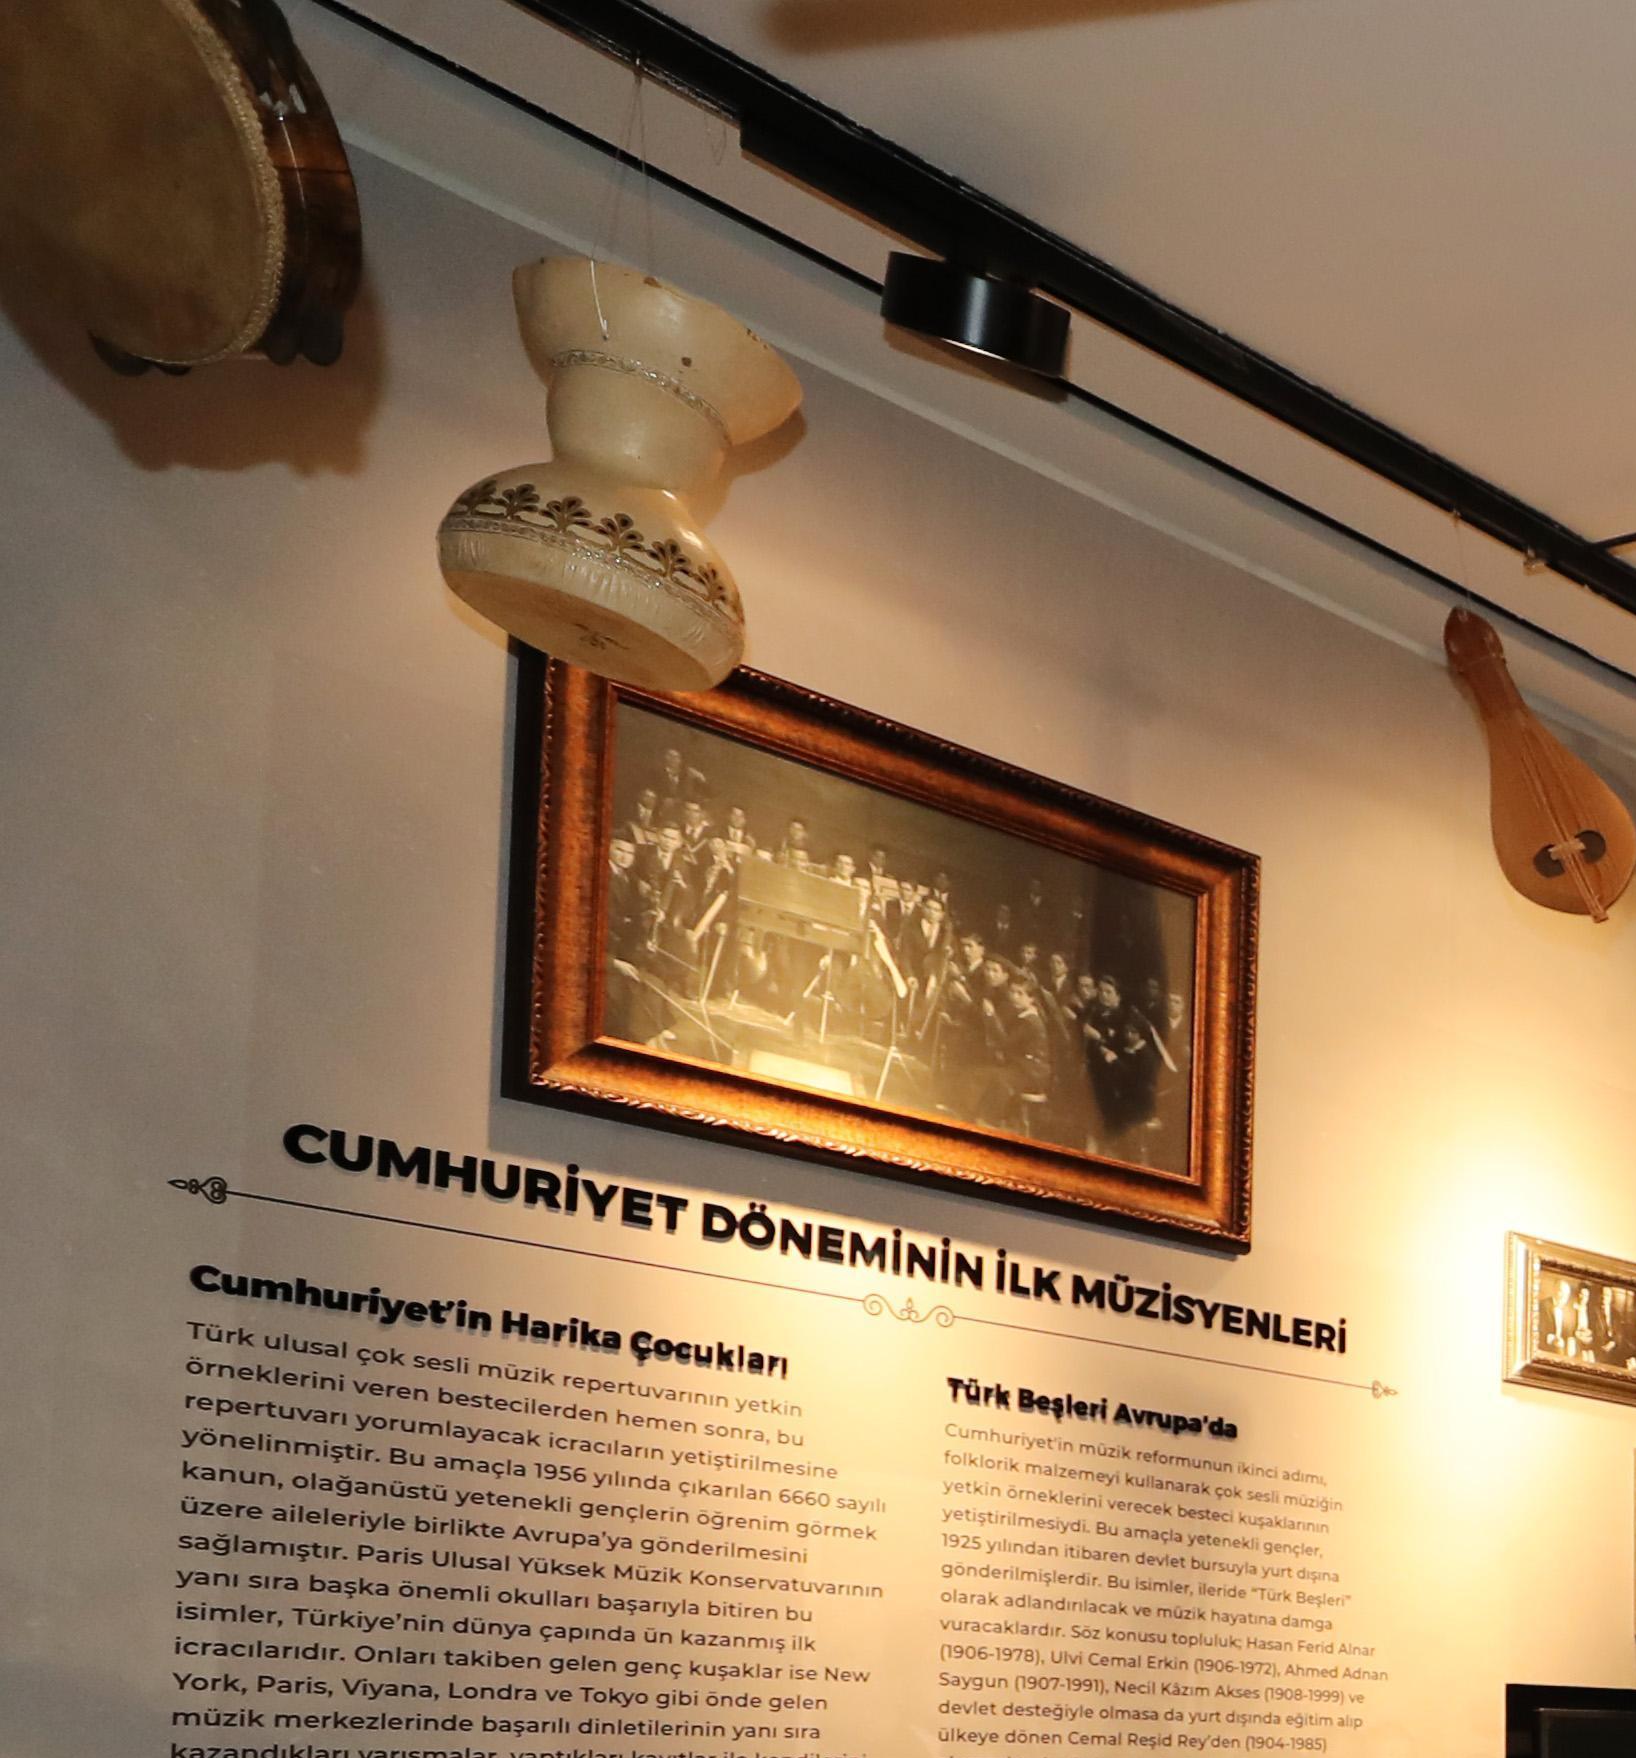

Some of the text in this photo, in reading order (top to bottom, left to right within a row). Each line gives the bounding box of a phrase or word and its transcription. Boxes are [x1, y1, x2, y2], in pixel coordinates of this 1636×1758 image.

[285, 1125, 1346, 1354] CUMHURİYET DÖNEMİNİN İLK MÜZİSYENLERİ
[190, 1265, 788, 1379] Cumhuriyet'in Harika Çocukları
[186, 1321, 802, 1416] Türk ulusal çok sesli müzik repertuvarının yetkin
[947, 1377, 1238, 1439] Türk Beşleri Avrupa'da
[944, 1423, 1327, 1487] Cumhuriyet'in müzik reformunun ikinci adımı,
[939, 1643, 1388, 1681] (1906-1978), Ulvi Cemal Erkin (1906-1972), Ahmed Adnan
